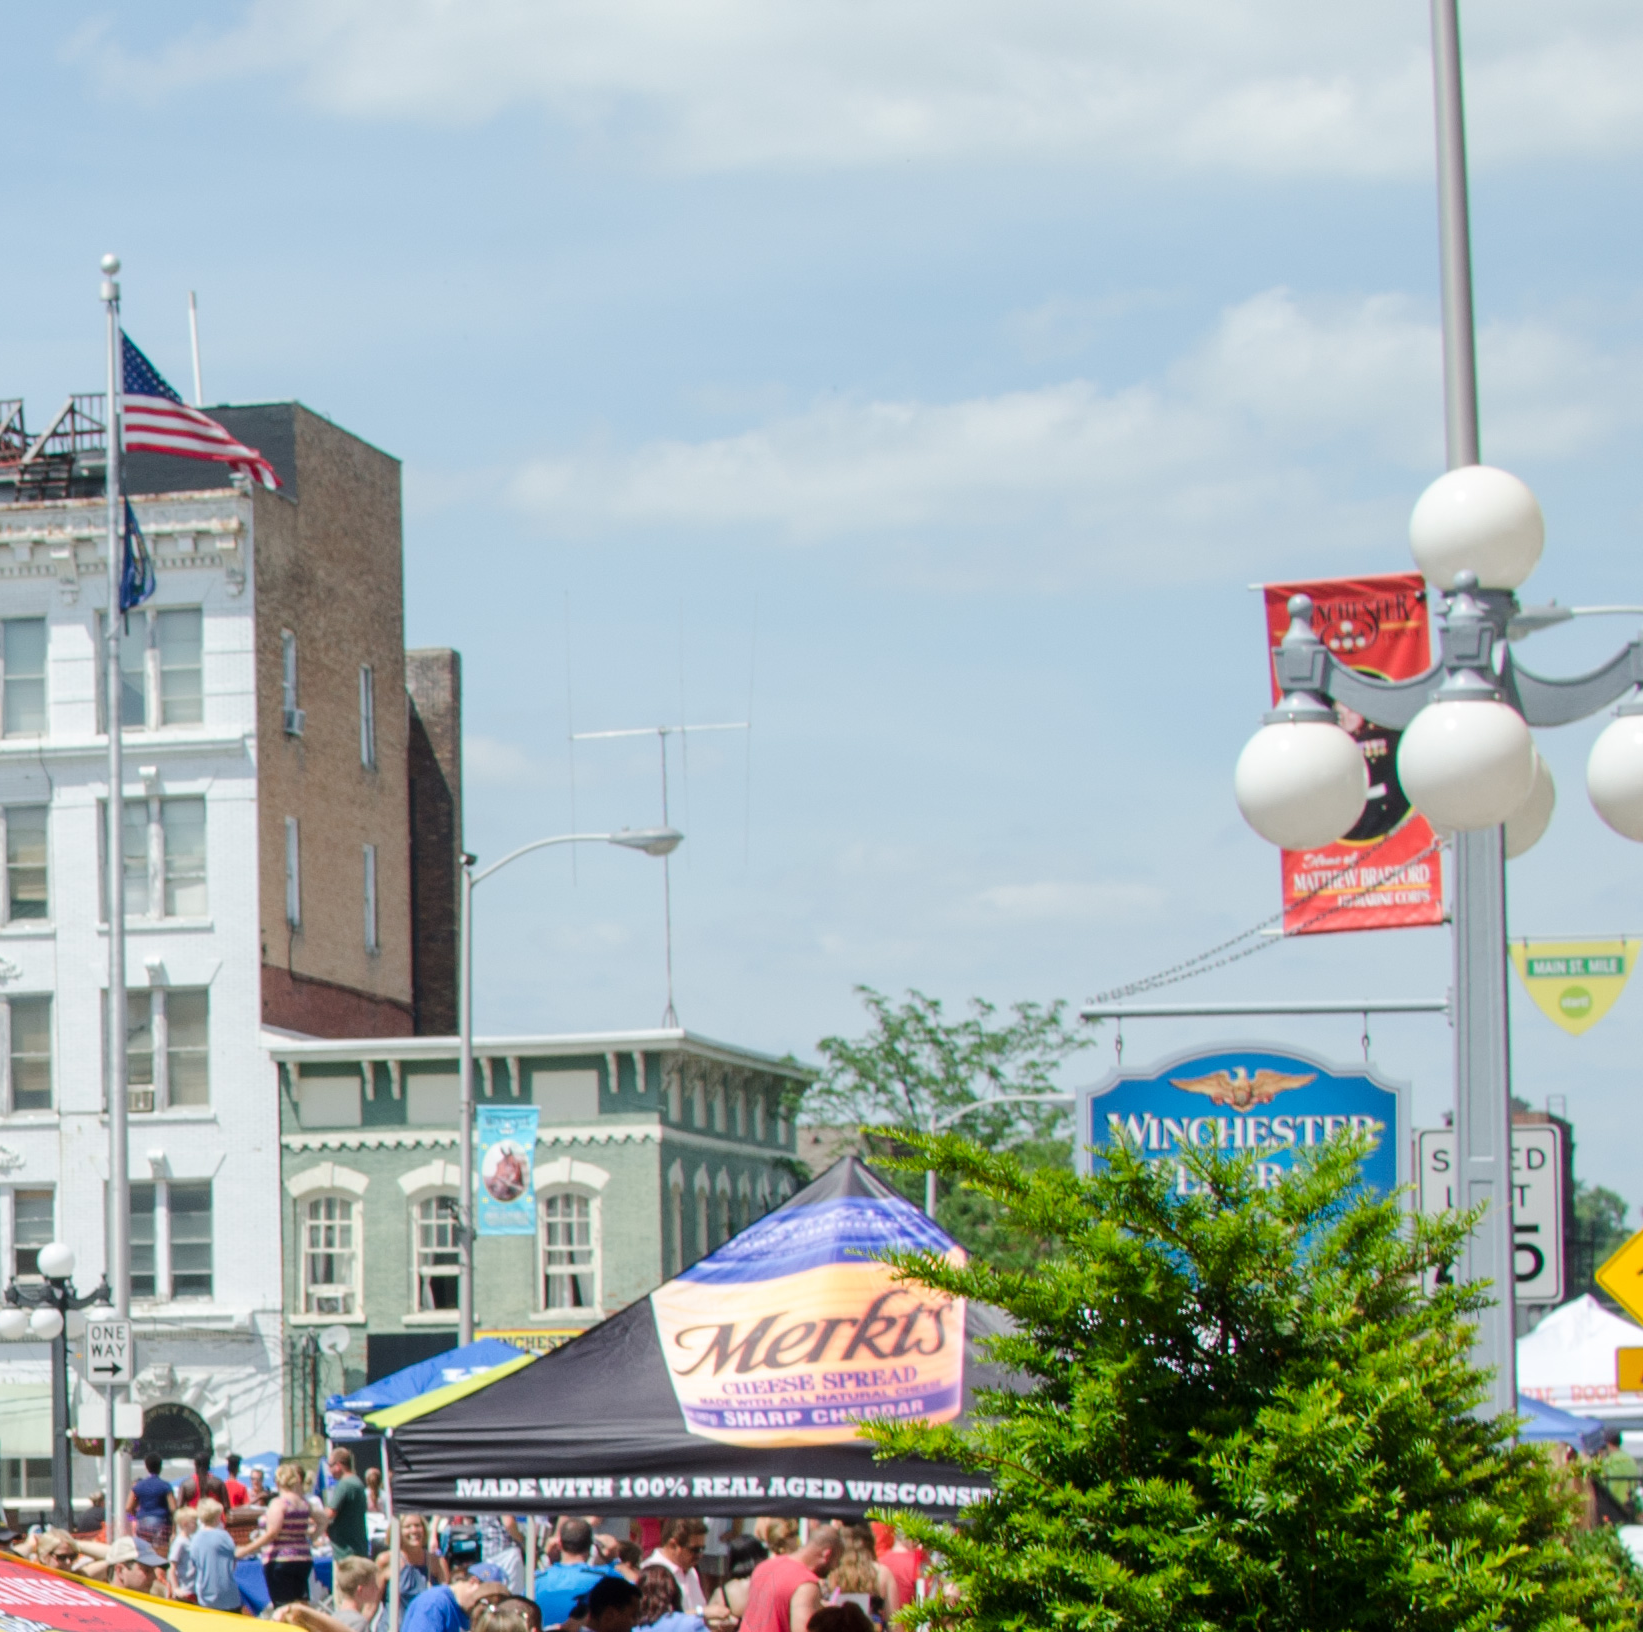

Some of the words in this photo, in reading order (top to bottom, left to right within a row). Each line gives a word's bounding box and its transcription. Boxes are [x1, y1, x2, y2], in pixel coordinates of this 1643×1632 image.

[1533, 960, 1567, 975] MAIN
[1569, 959, 1586, 974] ST.
[1589, 958, 1618, 974] MILE
[1106, 1112, 1377, 1151] WINCHESTER
[91, 1325, 125, 1341] ONE
[91, 1343, 126, 1358] WAY
[721, 1374, 815, 1396] CHEESE
[822, 1365, 918, 1391] SPREAD
[698, 1397, 733, 1407] MADE
[736, 1396, 773, 1406] WITH
[779, 1394, 808, 1404] ALL
[815, 1388, 889, 1403] NATURAL
[723, 1408, 802, 1428] SHARP
[811, 1399, 925, 1425] CHEDDAR
[456, 1477, 537, 1499] MADE
[539, 1477, 613, 1499] WITH
[619, 1475, 690, 1499] 100%
[692, 1476, 764, 1498] REAL
[767, 1477, 844, 1500] AGED
